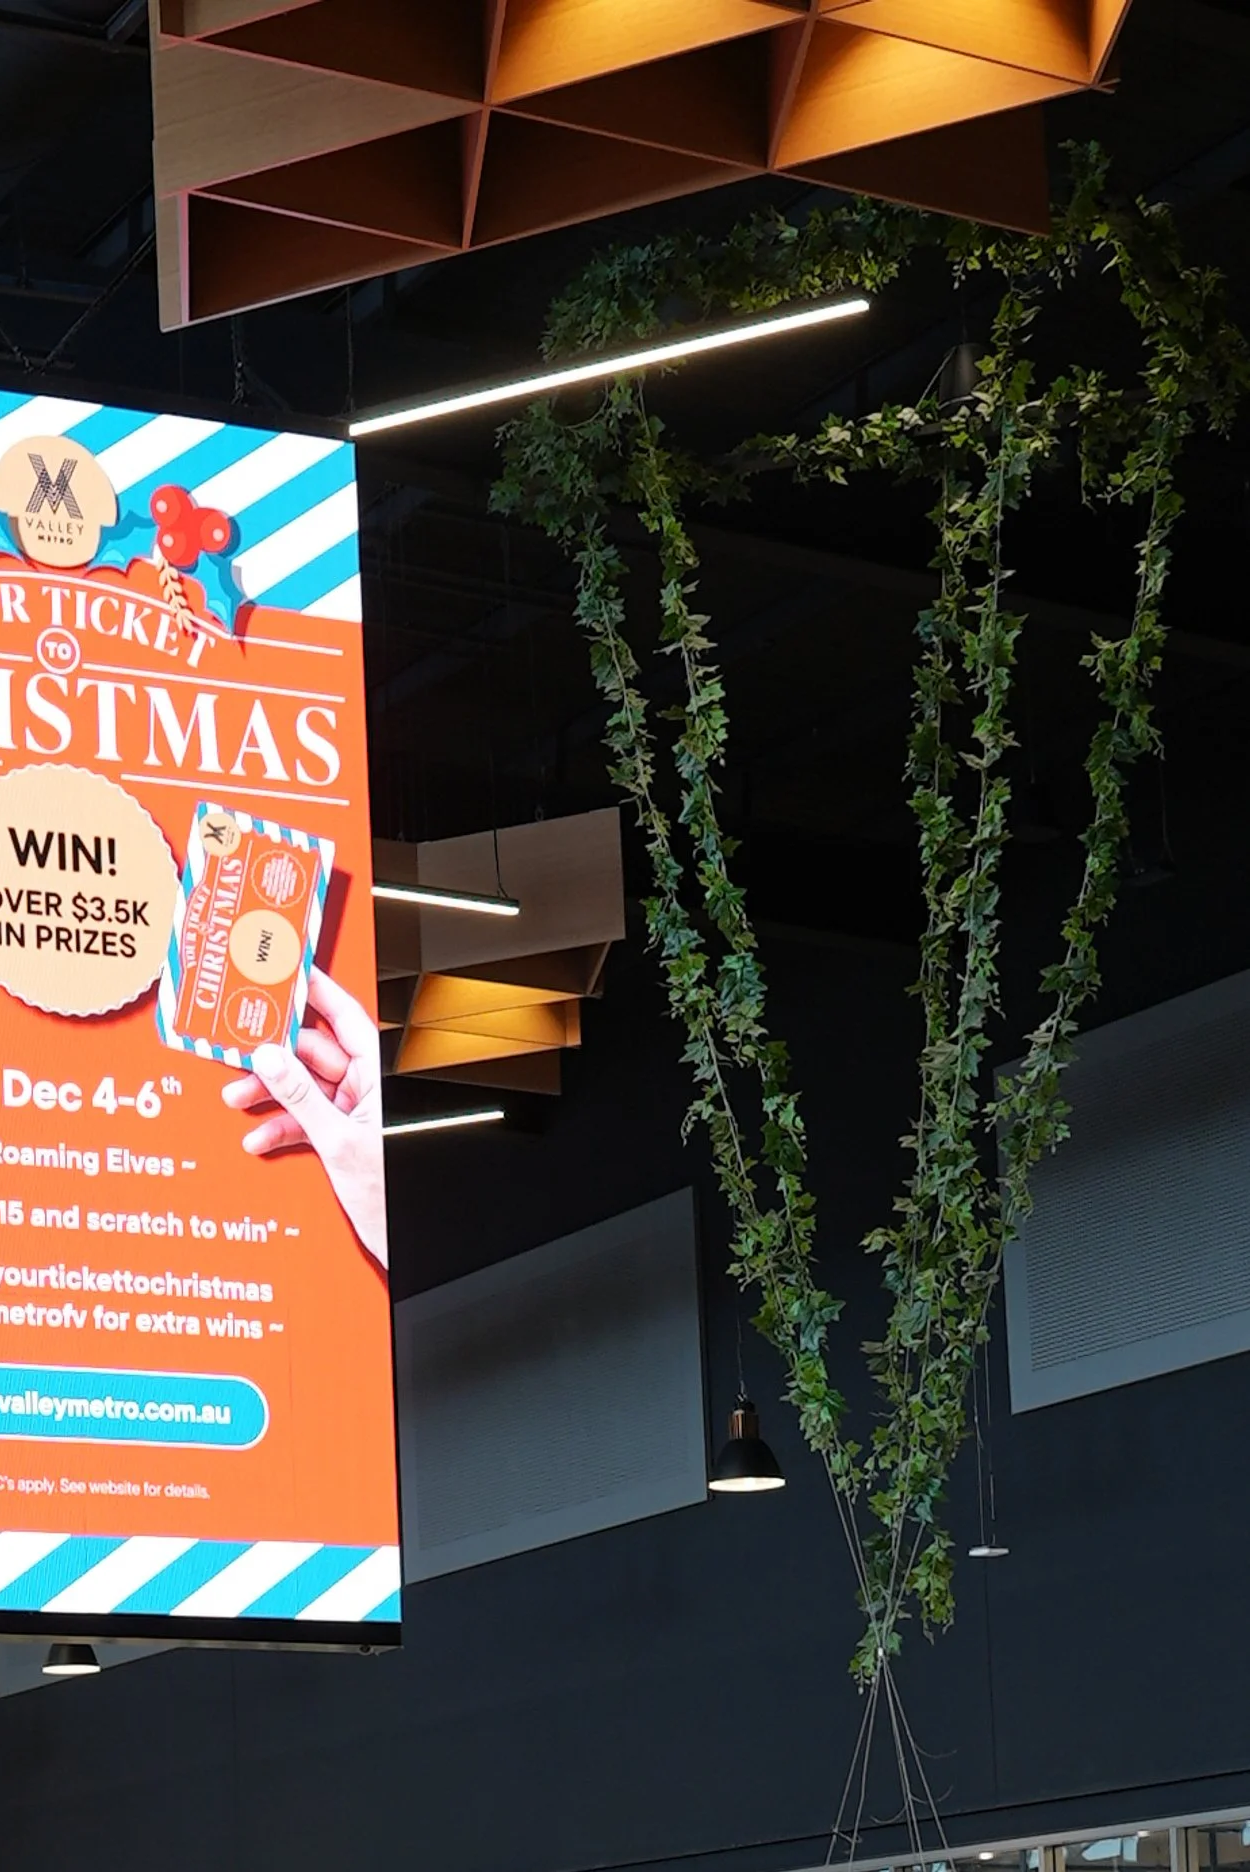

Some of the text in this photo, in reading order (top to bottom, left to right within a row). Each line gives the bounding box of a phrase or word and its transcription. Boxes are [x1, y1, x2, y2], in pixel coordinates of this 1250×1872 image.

[25, 516, 84, 536] VALLEY
[42, 584, 216, 669] TICKET
[45, 640, 72, 660] TO
[7, 826, 118, 877] WIN!
[71, 891, 150, 927] $3.5K
[36, 924, 137, 958] PRIZES
[195, 856, 243, 1011] CHRISTMAS
[256, 929, 274, 964] WIN!
[2, 1068, 82, 1112] Dec
[106, 1148, 175, 1177] Elves
[30, 1205, 80, 1230] and
[86, 1210, 184, 1239] scratch
[189, 1215, 218, 1239] to
[93, 1305, 131, 1331] for
[135, 1309, 200, 1335] extra
[206, 1311, 264, 1340] wins
[60, 1478, 86, 1493] See
[89, 1480, 141, 1496] website
[143, 1481, 162, 1497] for
